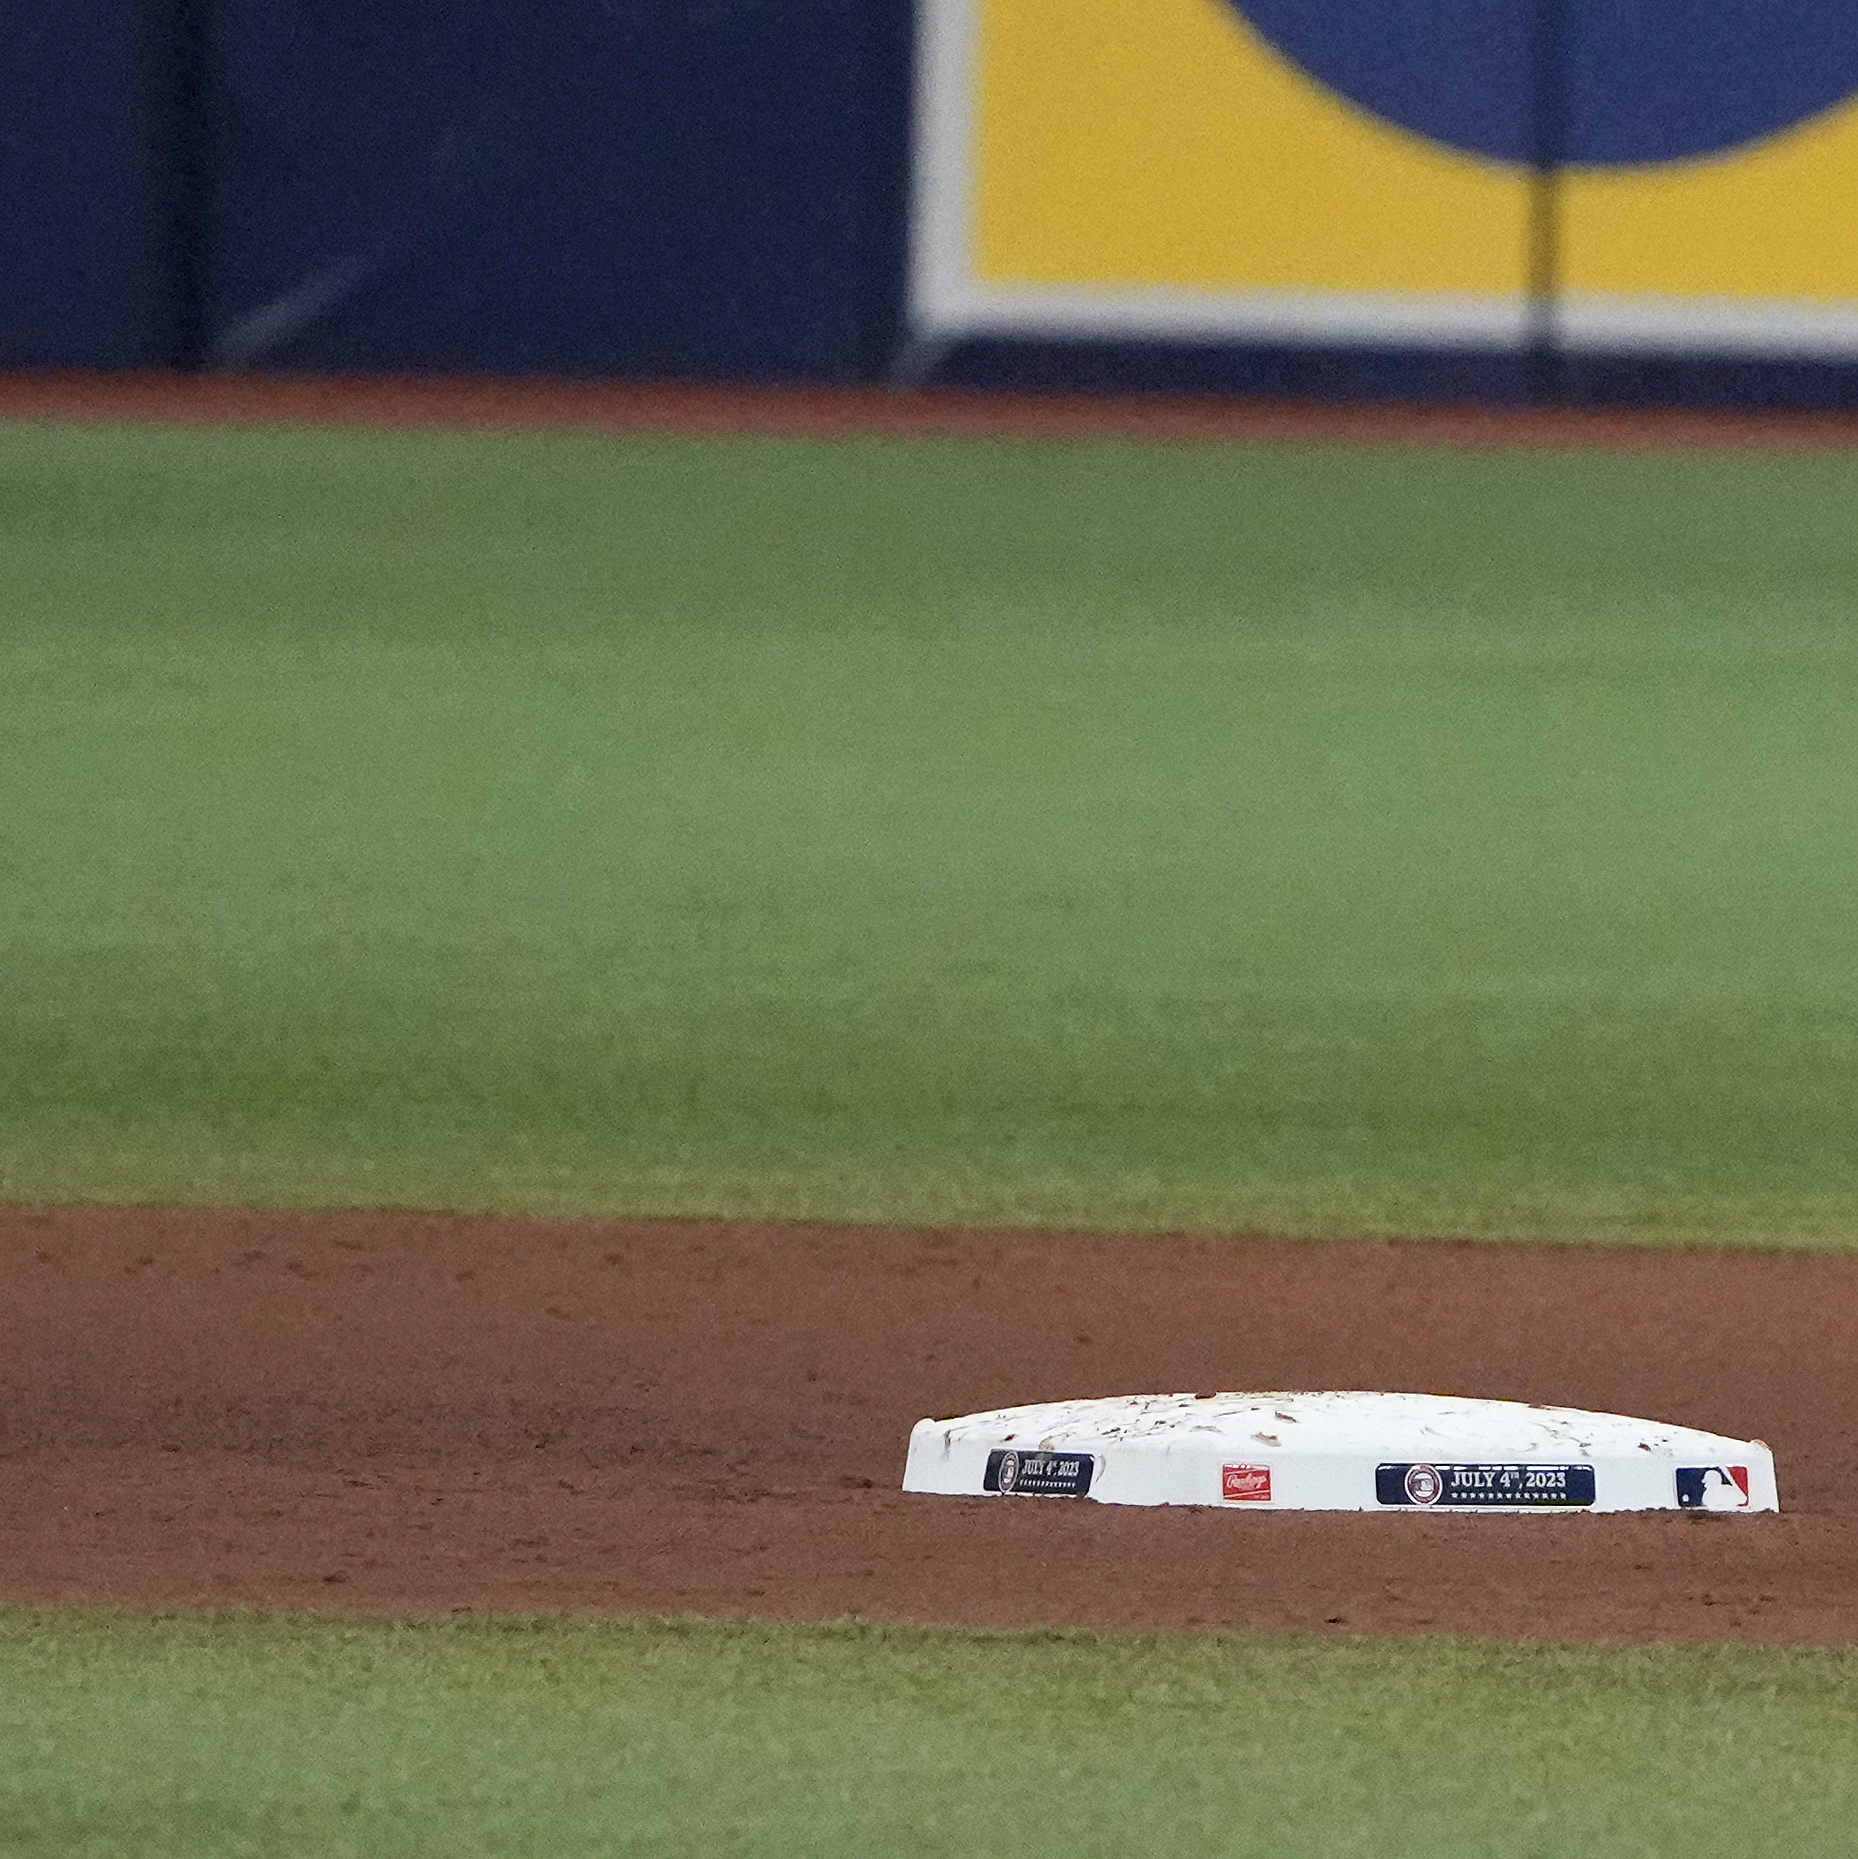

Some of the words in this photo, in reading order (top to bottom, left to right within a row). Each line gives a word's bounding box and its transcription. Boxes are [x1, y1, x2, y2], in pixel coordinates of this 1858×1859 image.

[1022, 1459, 1044, 1475] JULY
[1057, 1460, 1080, 1476] 2023
[1451, 1471, 1496, 1487] JULY
[1526, 1471, 1567, 1488] 2023
